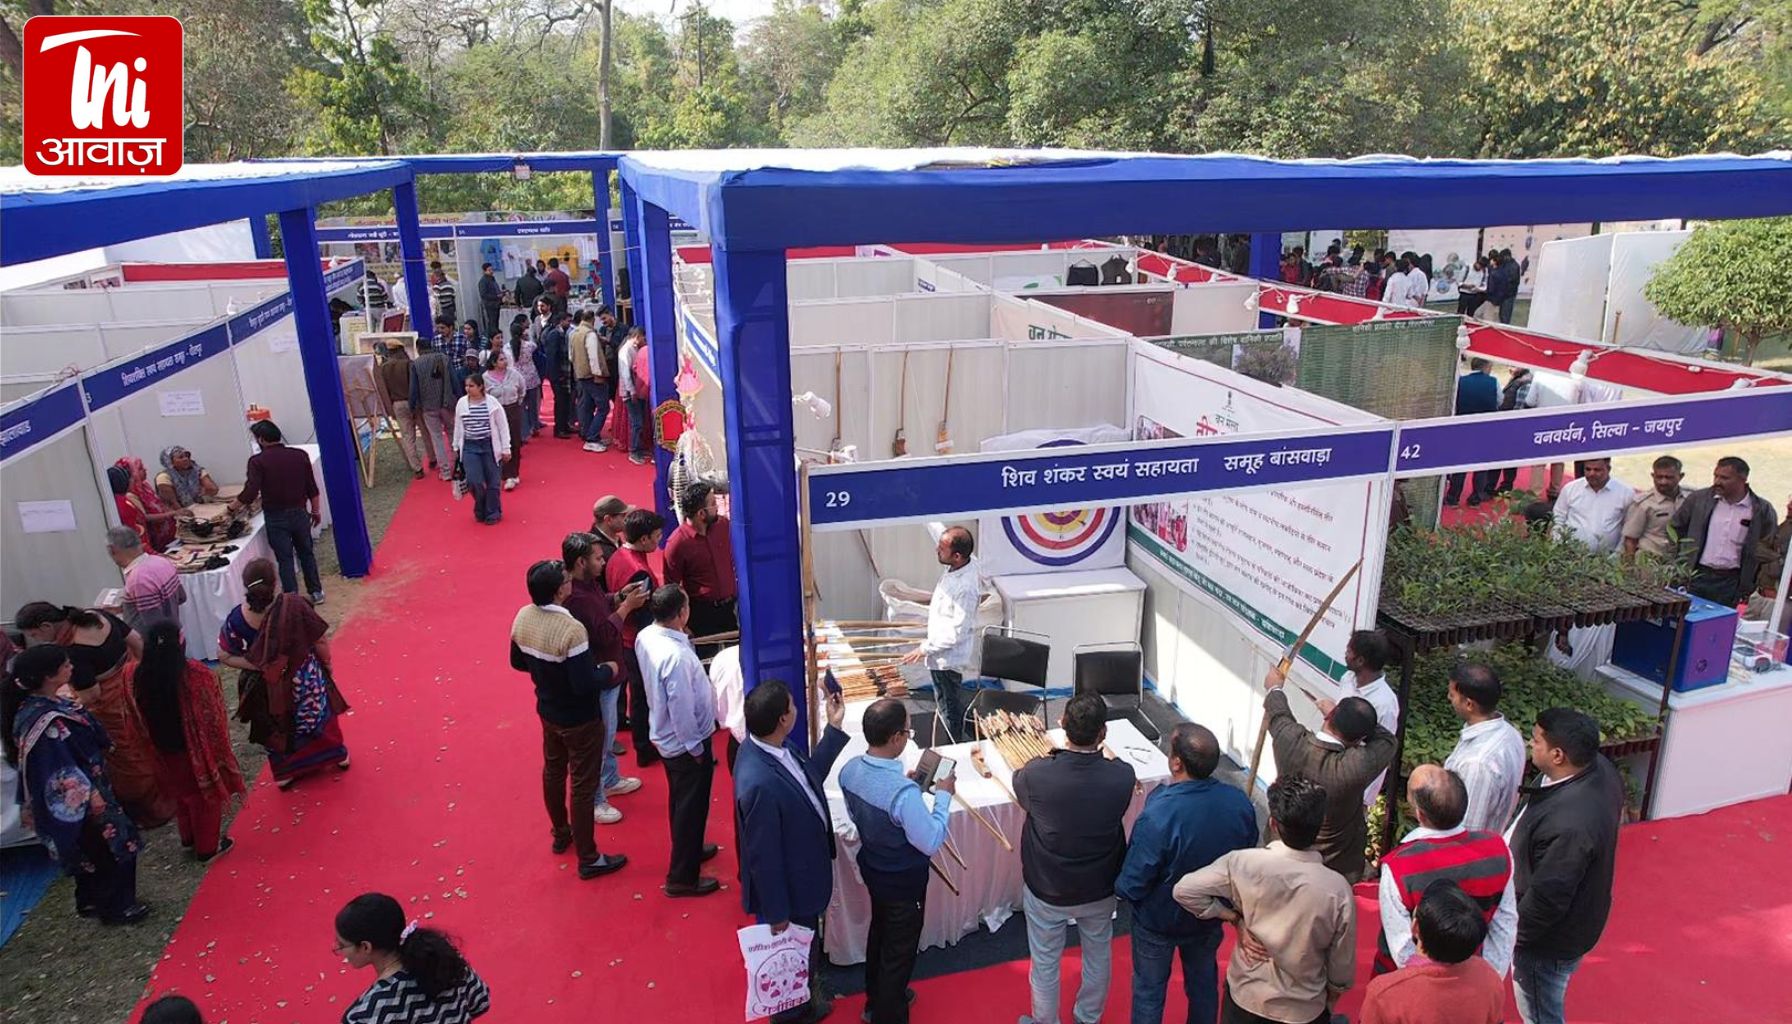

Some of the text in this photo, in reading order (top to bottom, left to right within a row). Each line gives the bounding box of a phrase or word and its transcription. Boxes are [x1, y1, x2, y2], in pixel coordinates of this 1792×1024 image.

[1534, 426, 1586, 446] वनवर्धन,
[1591, 422, 1628, 441] सिल्वा
[1644, 417, 1684, 437] जयपुर
[1401, 444, 1420, 459] 42
[1002, 447, 1332, 487] शिव शंकर स्वयं सहायता समूह बांसवाड़ा
[825, 491, 850, 508] 29
